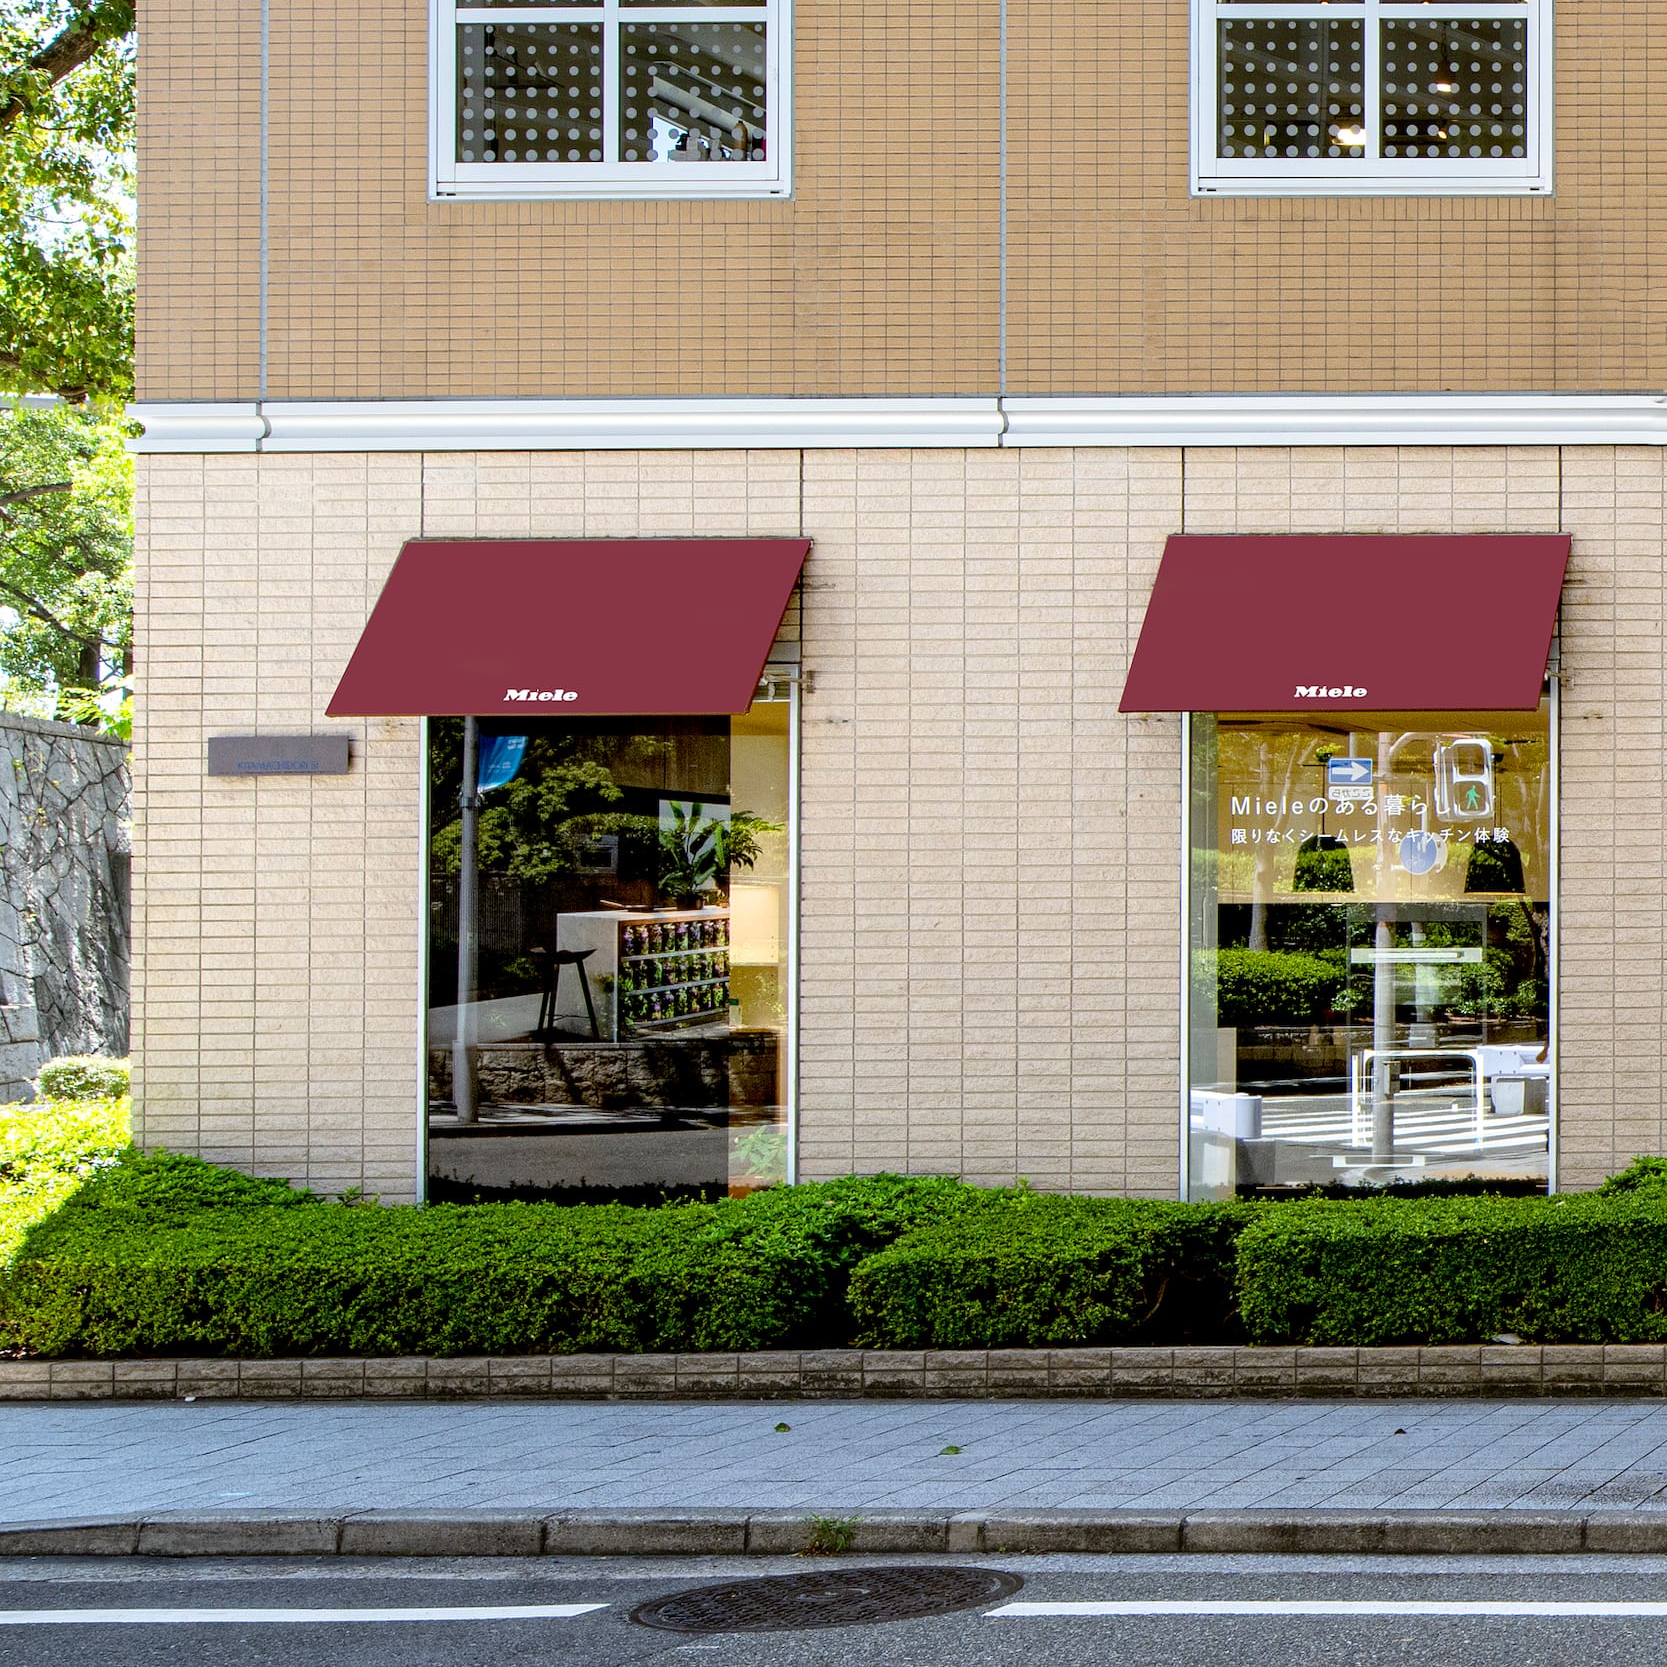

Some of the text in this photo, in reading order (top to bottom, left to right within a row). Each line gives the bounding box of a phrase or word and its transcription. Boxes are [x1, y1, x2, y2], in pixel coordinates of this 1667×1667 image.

[503, 689, 578, 701] Miele
[1294, 685, 1368, 698] Miele
[1231, 827, 1511, 844] 限りなくシームレスなキッチン体験
